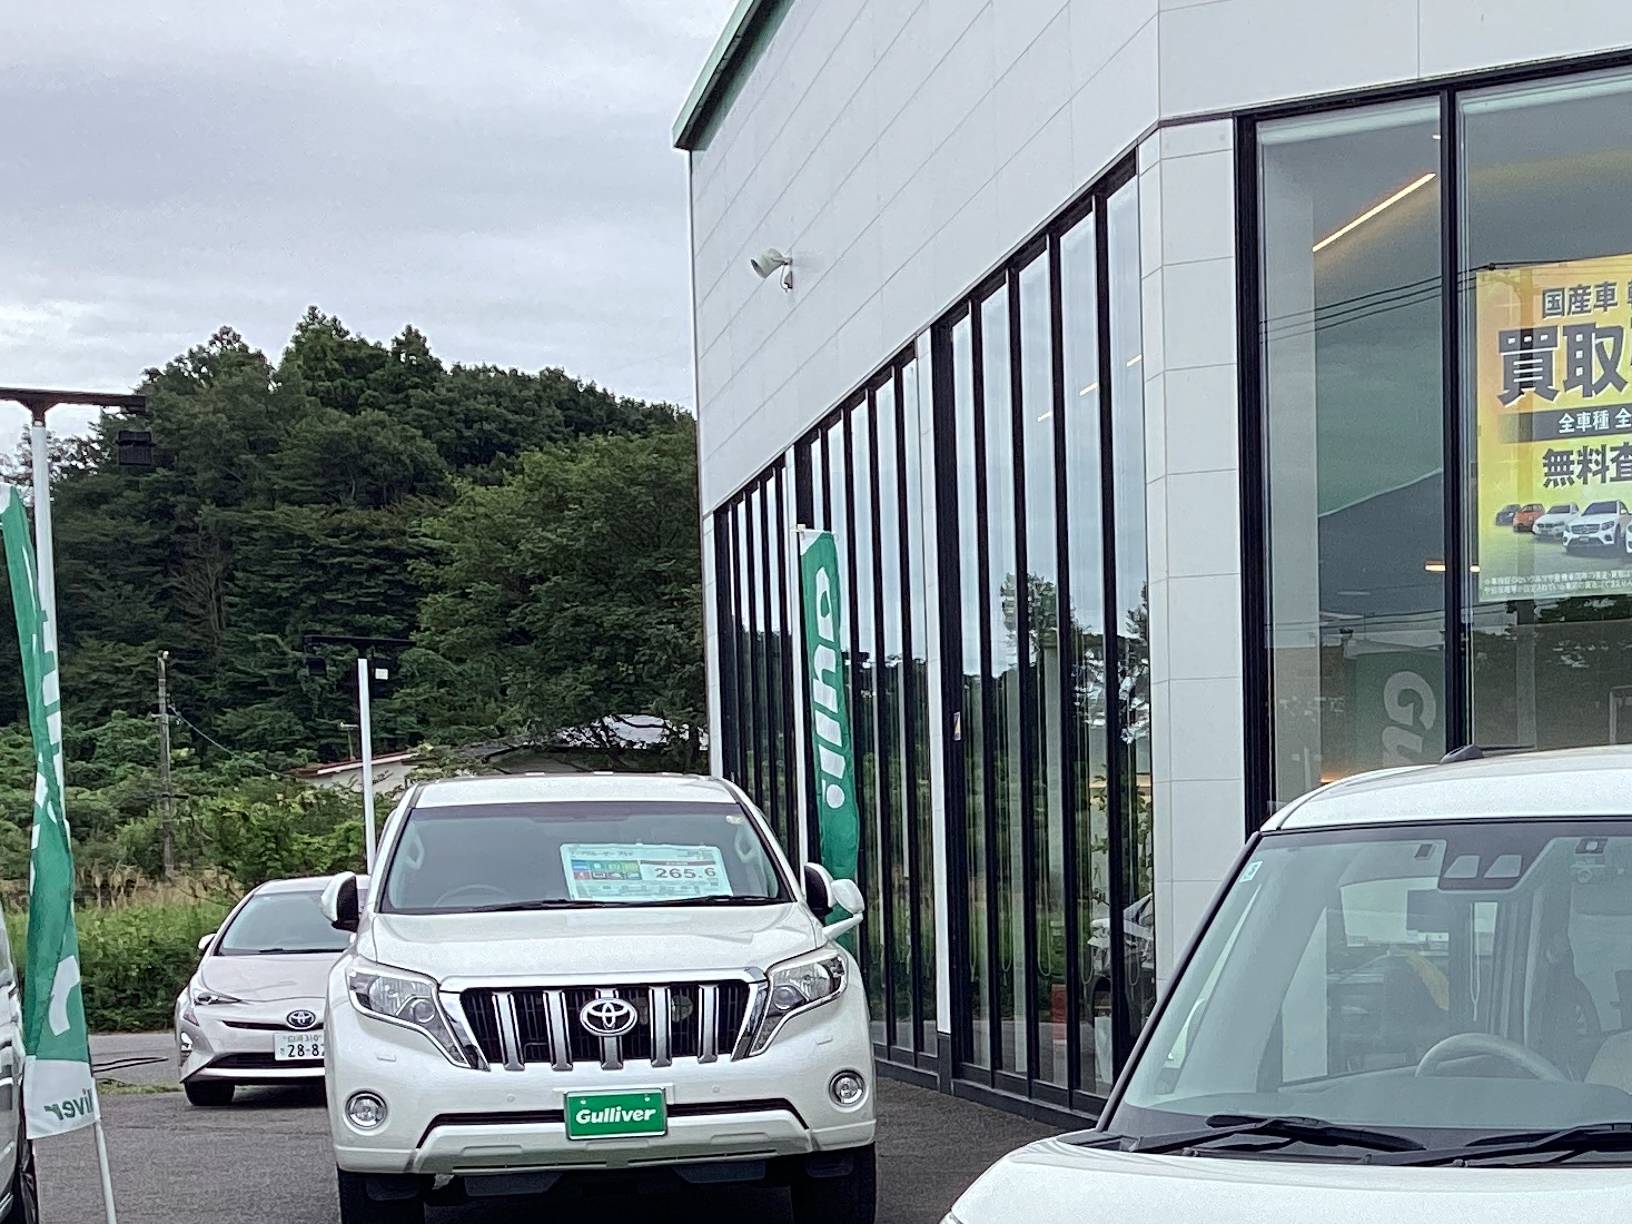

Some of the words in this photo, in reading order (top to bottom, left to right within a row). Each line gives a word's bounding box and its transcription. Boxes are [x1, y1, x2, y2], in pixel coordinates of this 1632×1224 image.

[1541, 282, 1617, 319] 国産車
[1558, 408, 1610, 435] 全車種
[655, 867, 717, 880] 265.6
[288, 1043, 325, 1057] 28-8
[575, 1105, 657, 1124] Gulliver
